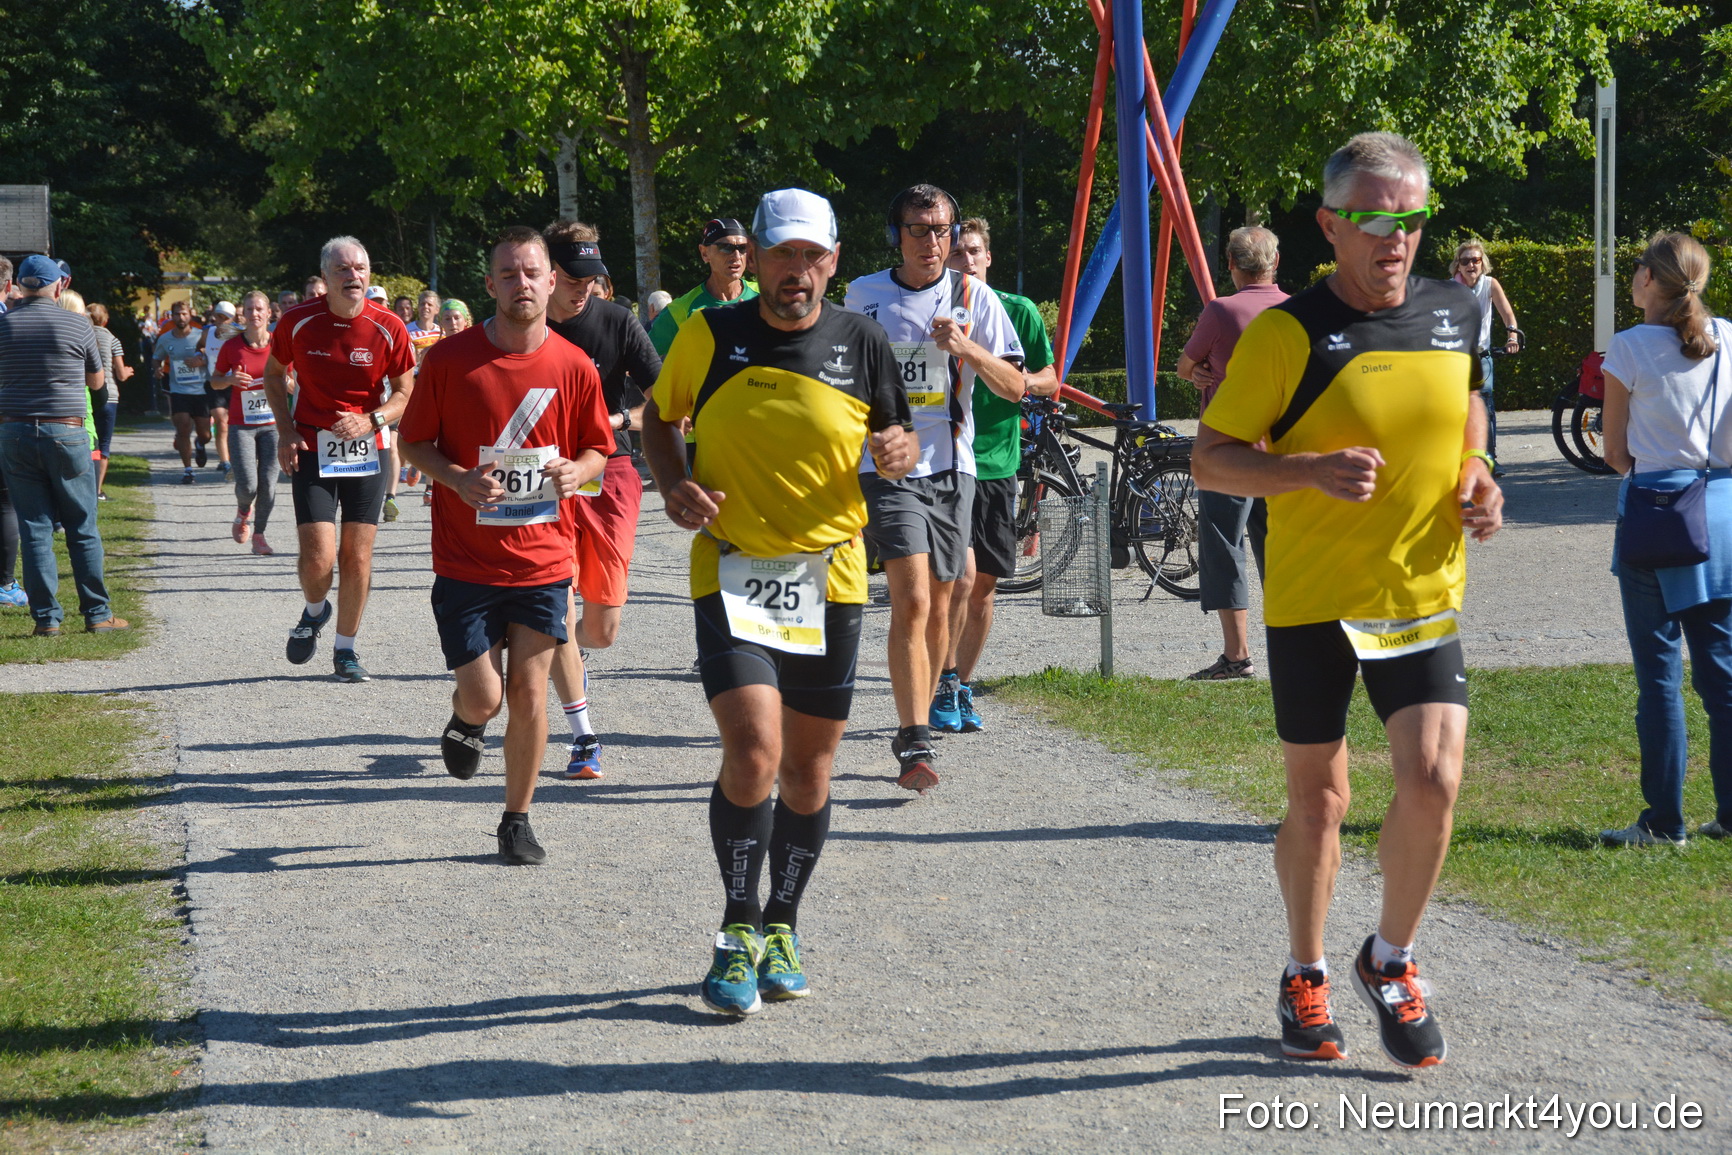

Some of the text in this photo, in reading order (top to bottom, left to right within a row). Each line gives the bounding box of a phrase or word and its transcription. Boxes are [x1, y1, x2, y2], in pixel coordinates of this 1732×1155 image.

[863, 302, 879, 312] JOGIS
[1433, 309, 1449, 317] TSV
[832, 345, 848, 353] TSV
[894, 347, 926, 356] BOCK
[1328, 342, 1351, 350] erima
[729, 354, 749, 362] erima
[1361, 364, 1393, 374] Dieter
[747, 378, 777, 390] Bernd
[818, 371, 854, 385] Burgthann
[327, 440, 369, 458] 2149
[491, 469, 545, 493] 2617
[505, 505, 534, 517] Daniel
[751, 559, 798, 573] BOCK
[744, 578, 801, 611] 225
[757, 624, 791, 641] Bernd
[1379, 630, 1420, 648] Dieter
